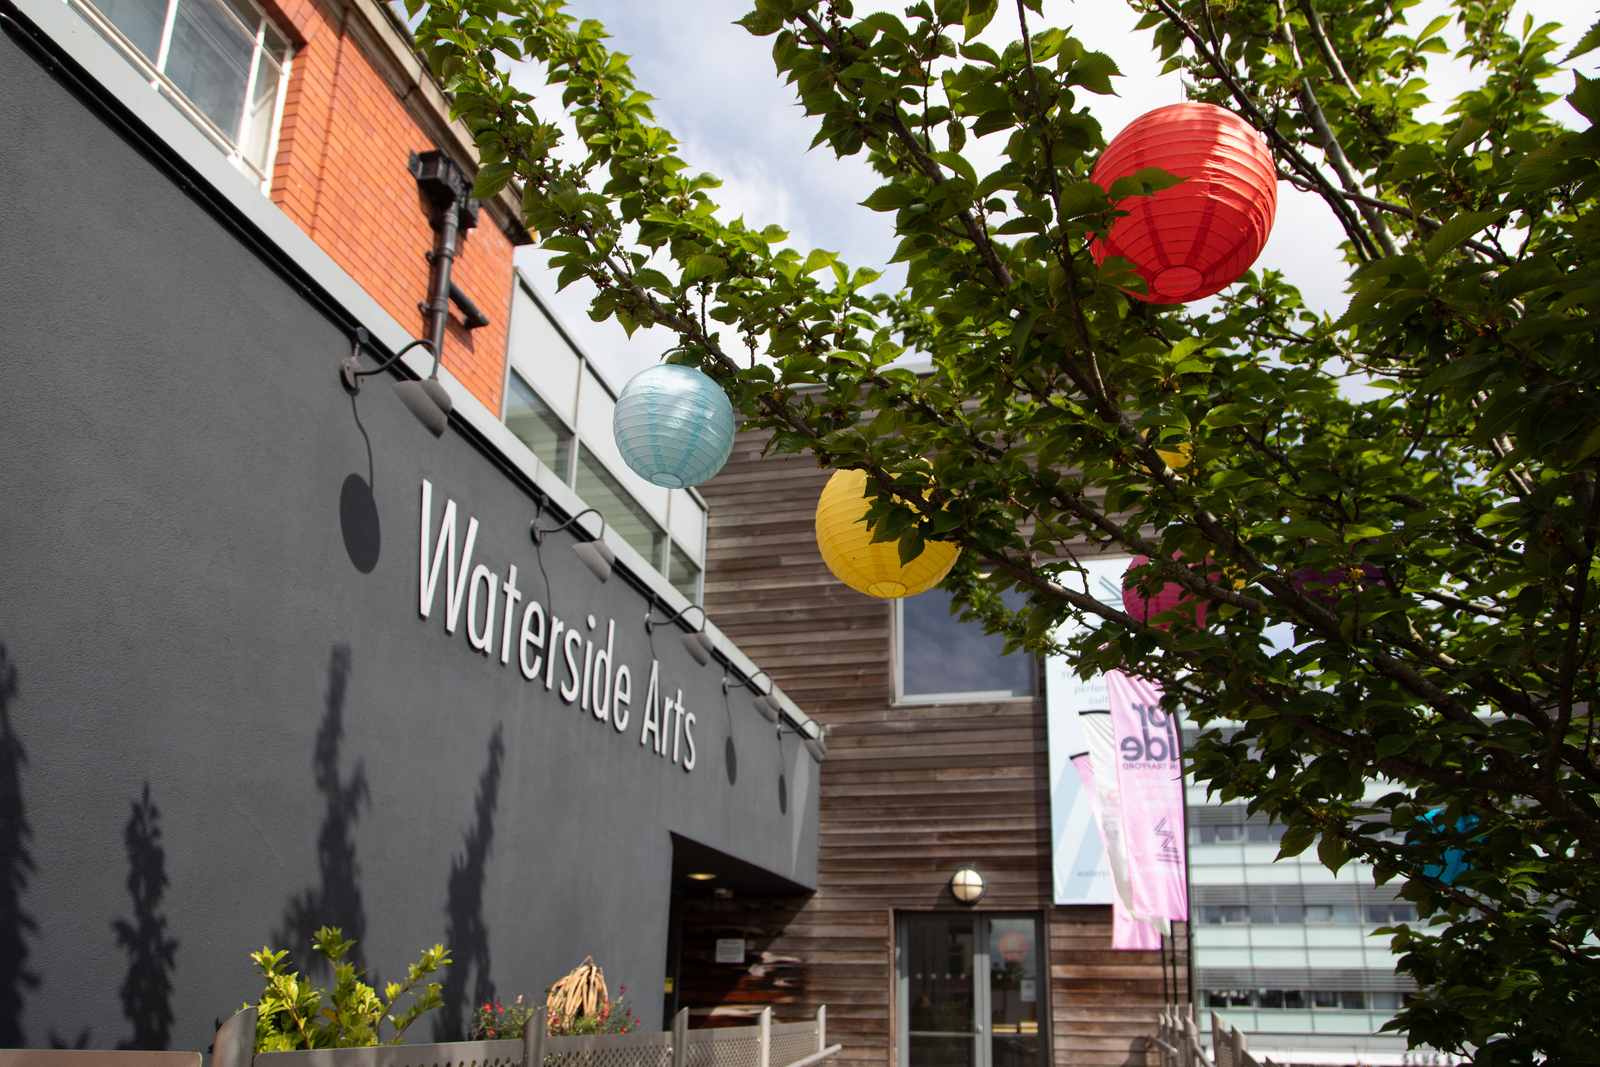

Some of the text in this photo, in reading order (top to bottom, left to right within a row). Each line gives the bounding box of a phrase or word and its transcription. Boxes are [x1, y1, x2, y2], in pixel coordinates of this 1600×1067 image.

[420, 478, 697, 771] Waterside Arts
[1074, 684, 1108, 695] perfor
[1089, 696, 1109, 704] cult
[1077, 869, 1110, 878] watersi
